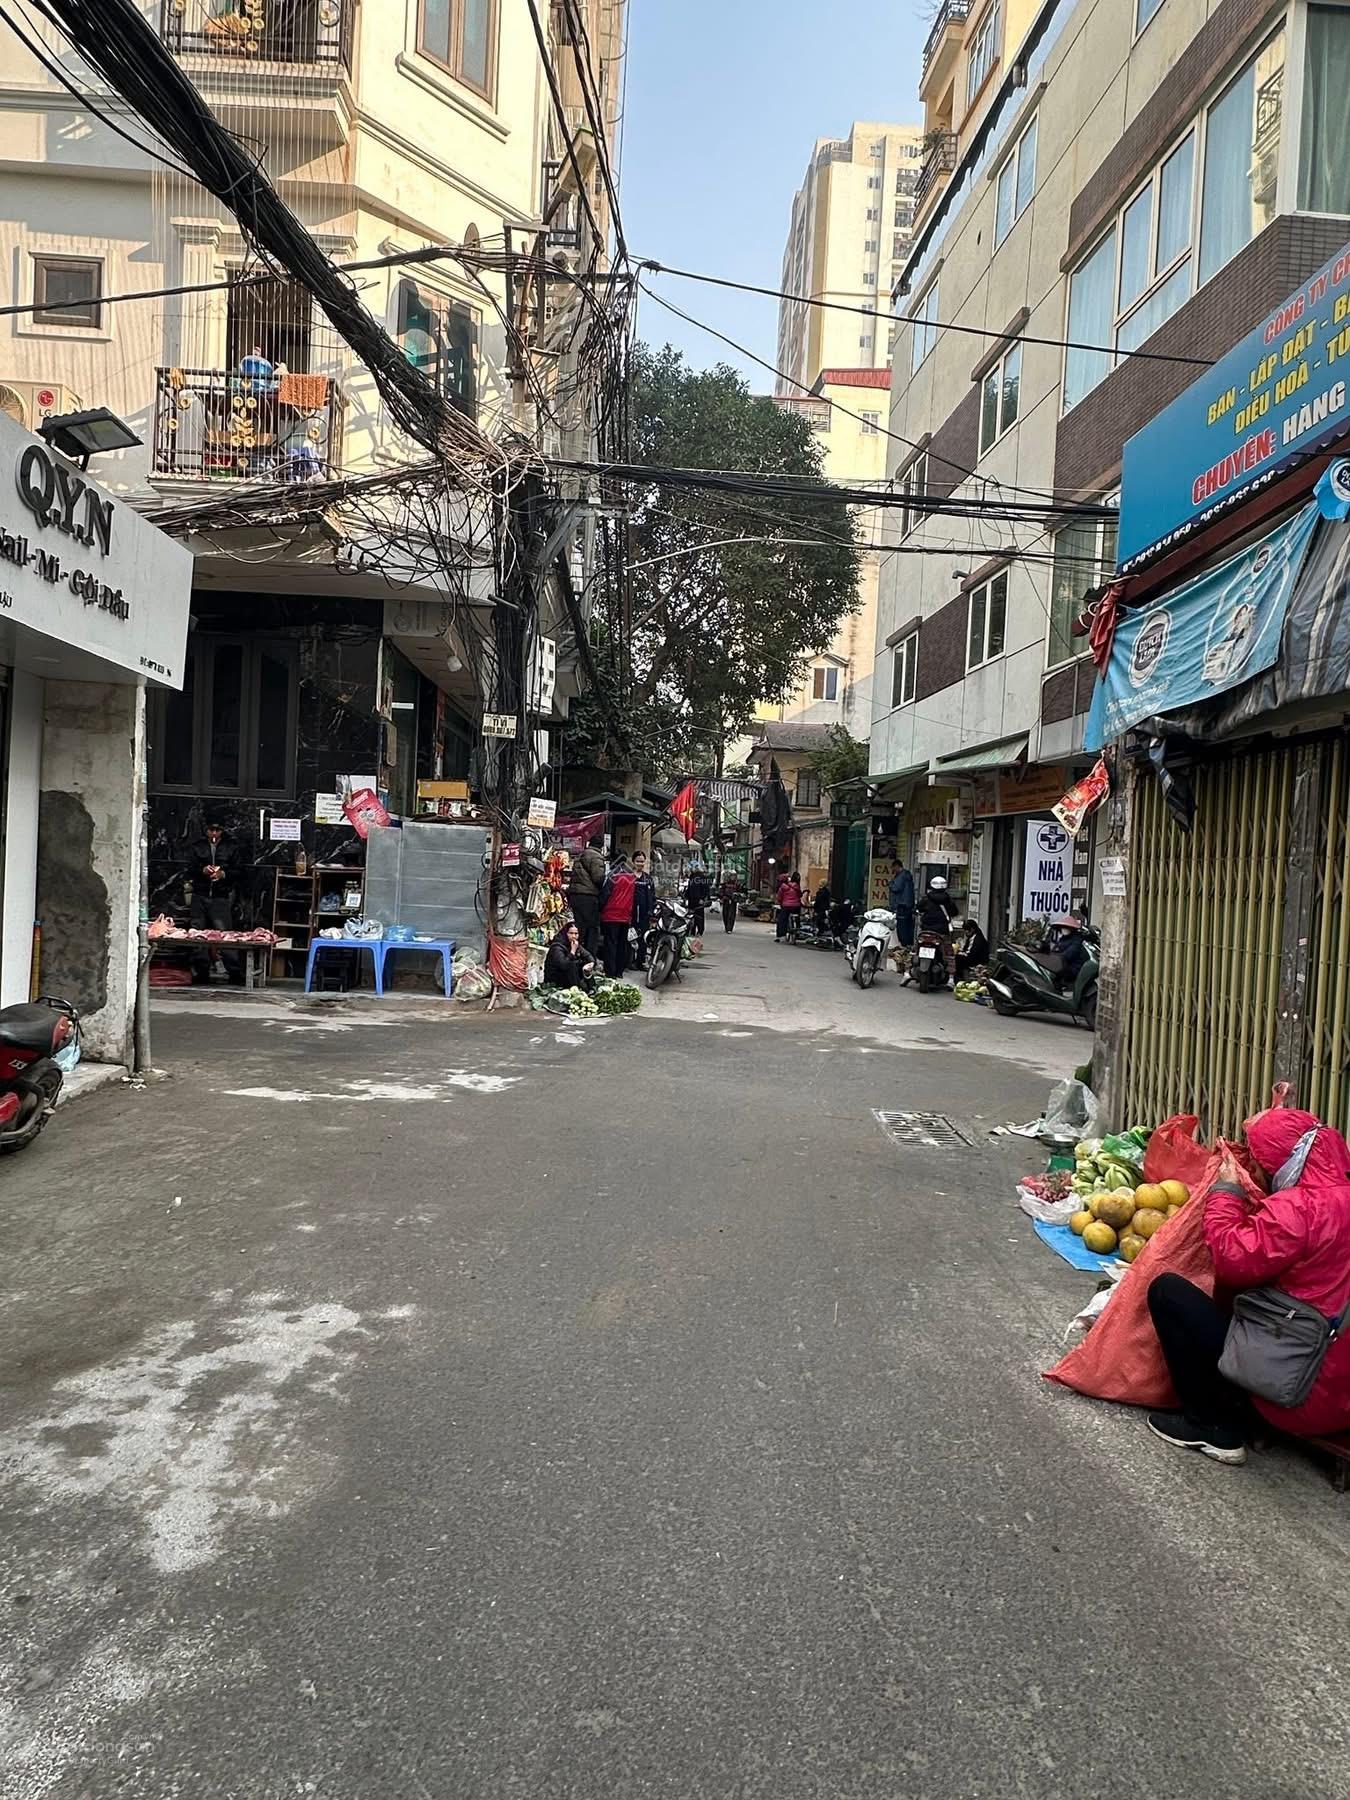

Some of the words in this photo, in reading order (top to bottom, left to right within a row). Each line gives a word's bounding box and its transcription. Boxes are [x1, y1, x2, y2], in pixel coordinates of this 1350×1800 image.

[1308, 269, 1329, 307] TY
[38, 408, 52, 417] LG
[1282, 380, 1346, 446] HÀNG
[16, 444, 114, 556] Q.Y.N
[1038, 856, 1064, 881] NHÀ
[1030, 885, 1069, 913] THUỐC
